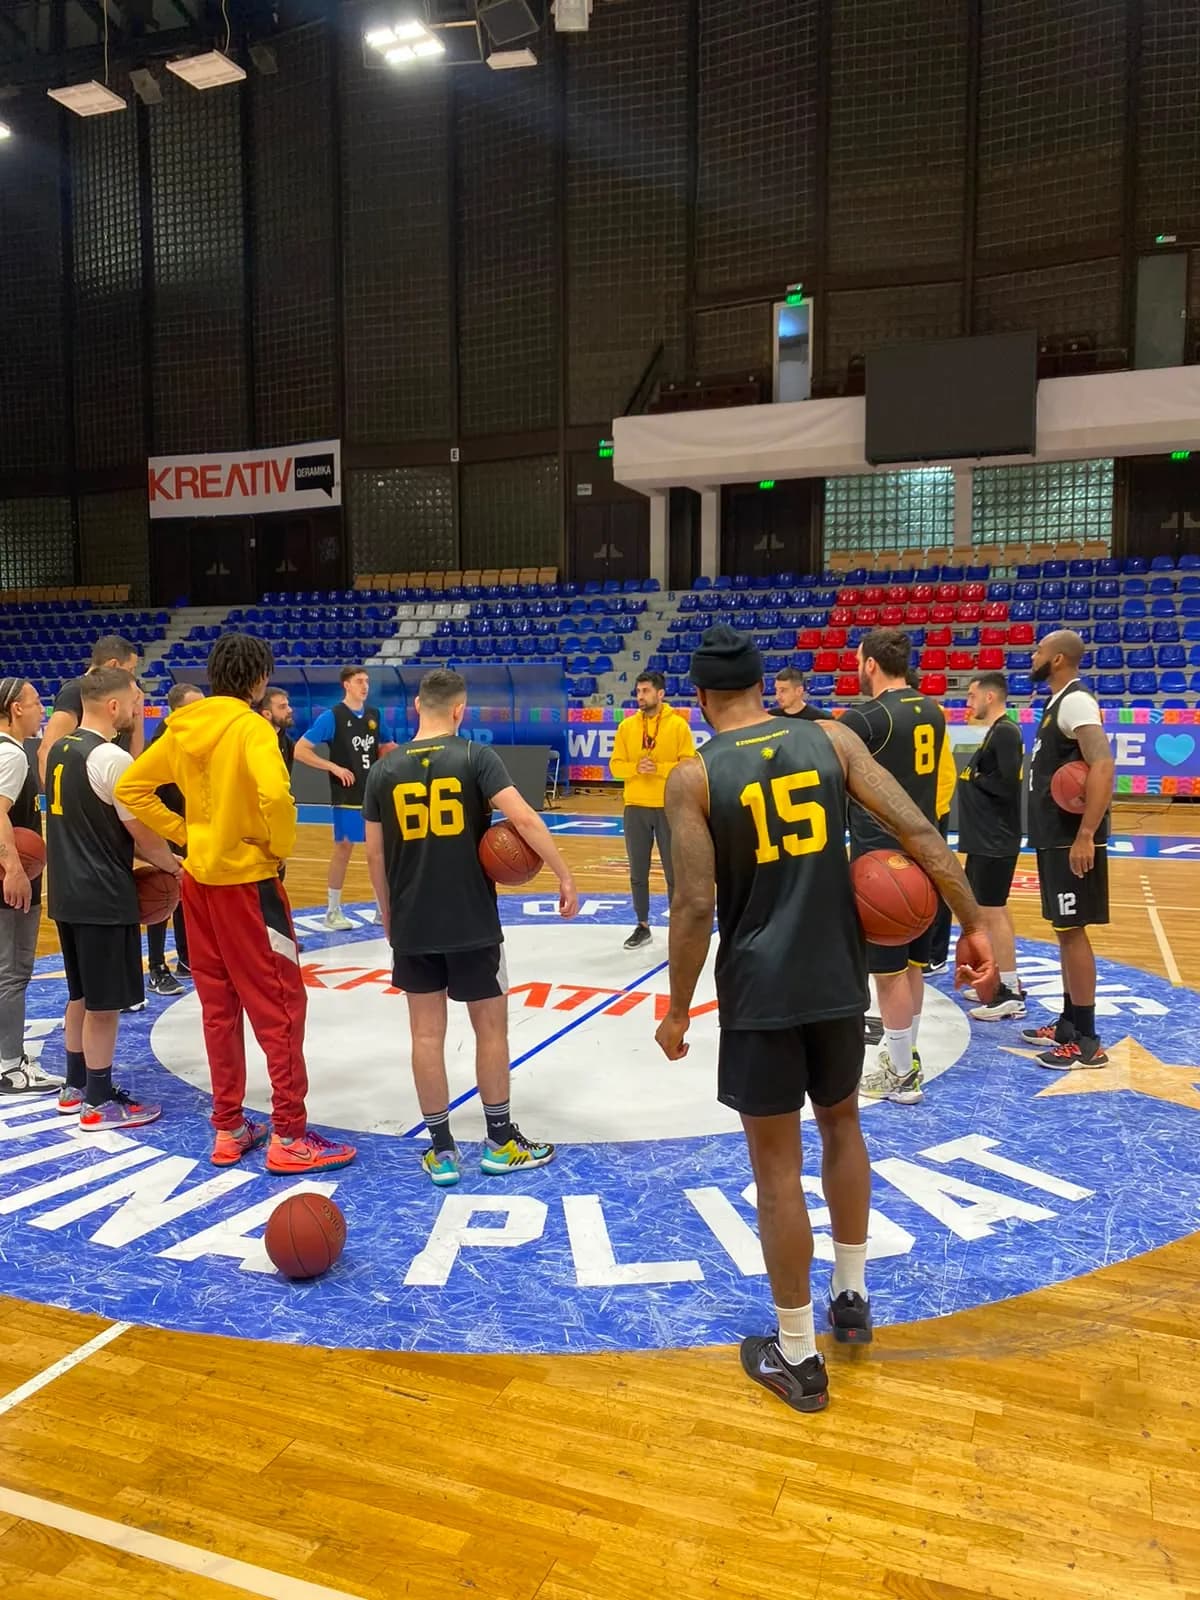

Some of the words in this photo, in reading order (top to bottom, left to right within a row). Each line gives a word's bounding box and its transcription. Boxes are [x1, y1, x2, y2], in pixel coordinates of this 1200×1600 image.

[149, 457, 293, 502] KREATIV
[656, 610, 664, 621] 7
[643, 629, 652, 641] 6
[632, 650, 640, 662] 5
[618, 671, 627, 682] 4
[606, 693, 614, 706] 3
[361, 753, 370, 769] 5
[913, 723, 936, 776] 8
[1103, 732, 1146, 766] E
[50, 763, 65, 816] 1
[392, 776, 465, 841] 66
[739, 769, 828, 864] 15
[1057, 892, 1077, 916] 12
